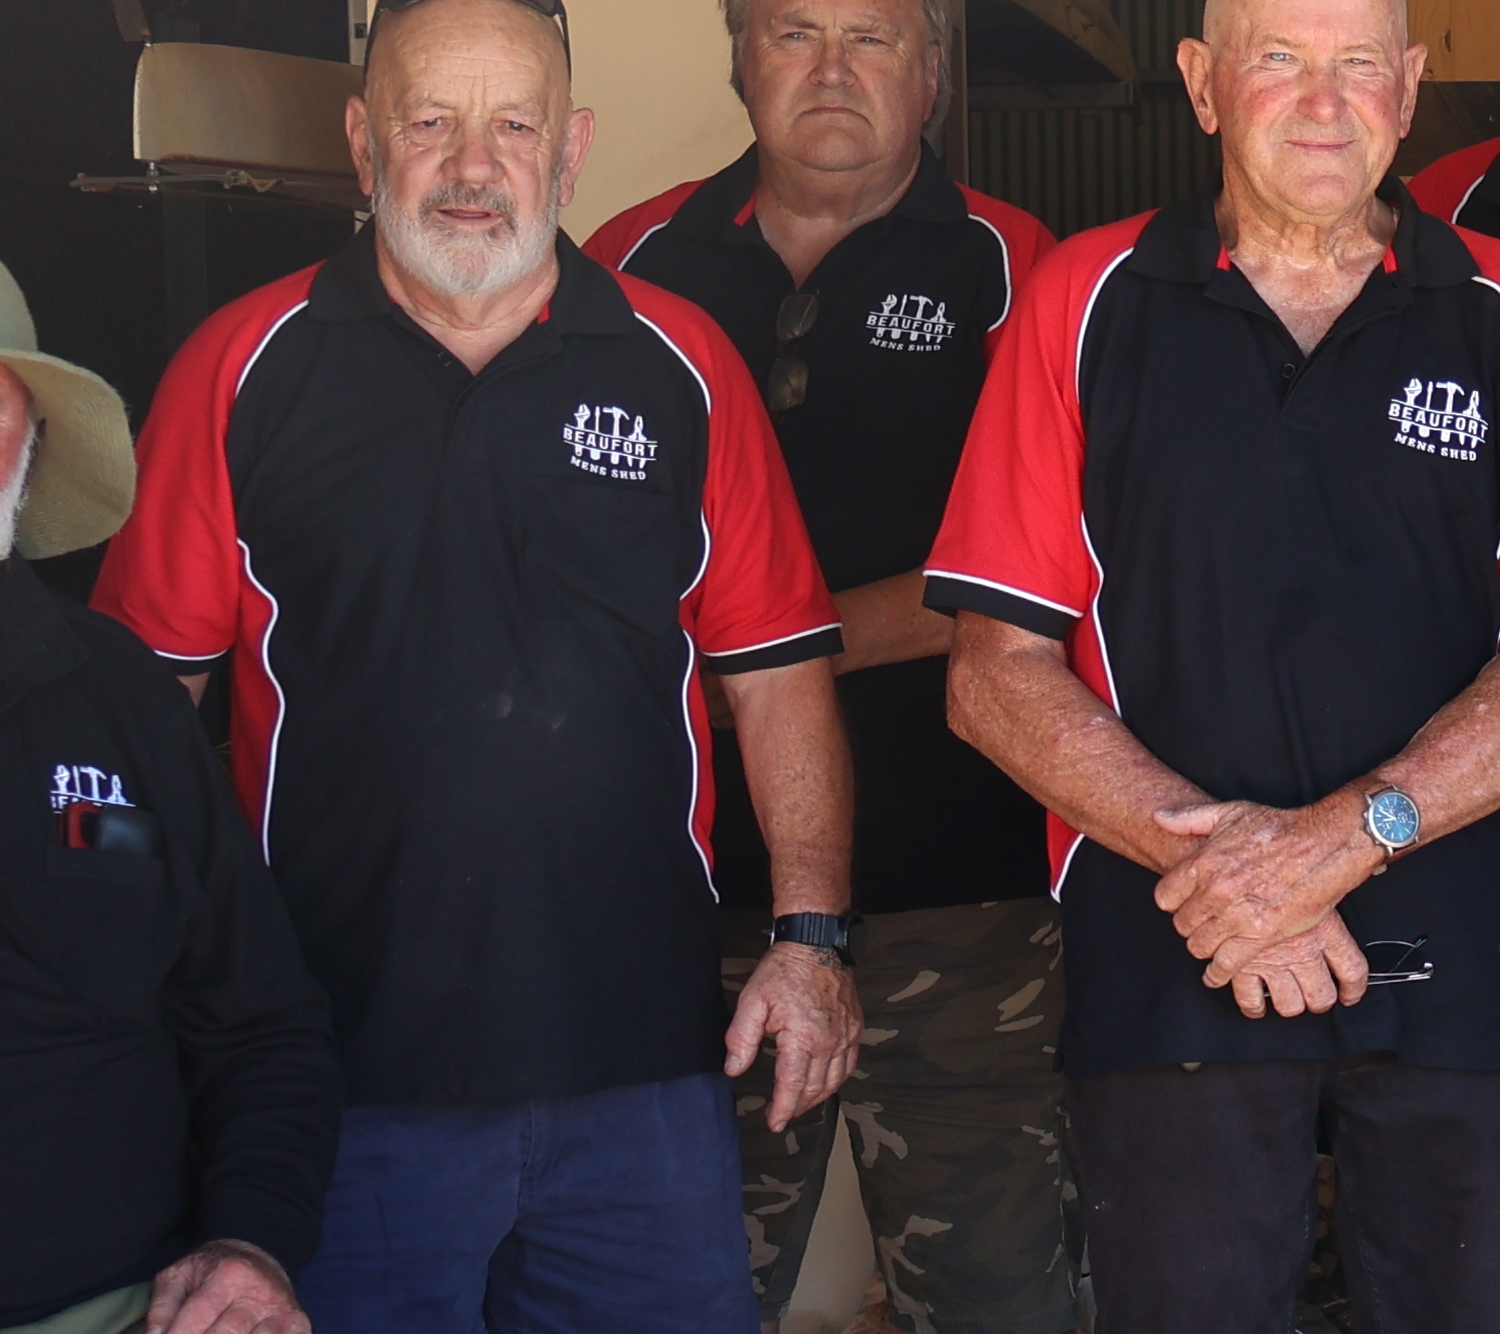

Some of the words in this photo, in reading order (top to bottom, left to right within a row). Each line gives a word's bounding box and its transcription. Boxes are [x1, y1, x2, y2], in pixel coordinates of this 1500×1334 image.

[866, 315, 955, 335] BEAUFORT
[869, 337, 904, 351] MENS
[1388, 403, 1488, 438] BEAUFORT
[563, 427, 658, 457] BEAUFORT
[1394, 433, 1436, 453] MENS
[1440, 447, 1477, 461] SHED
[570, 455, 607, 476] MENS
[611, 469, 646, 481] SHED
